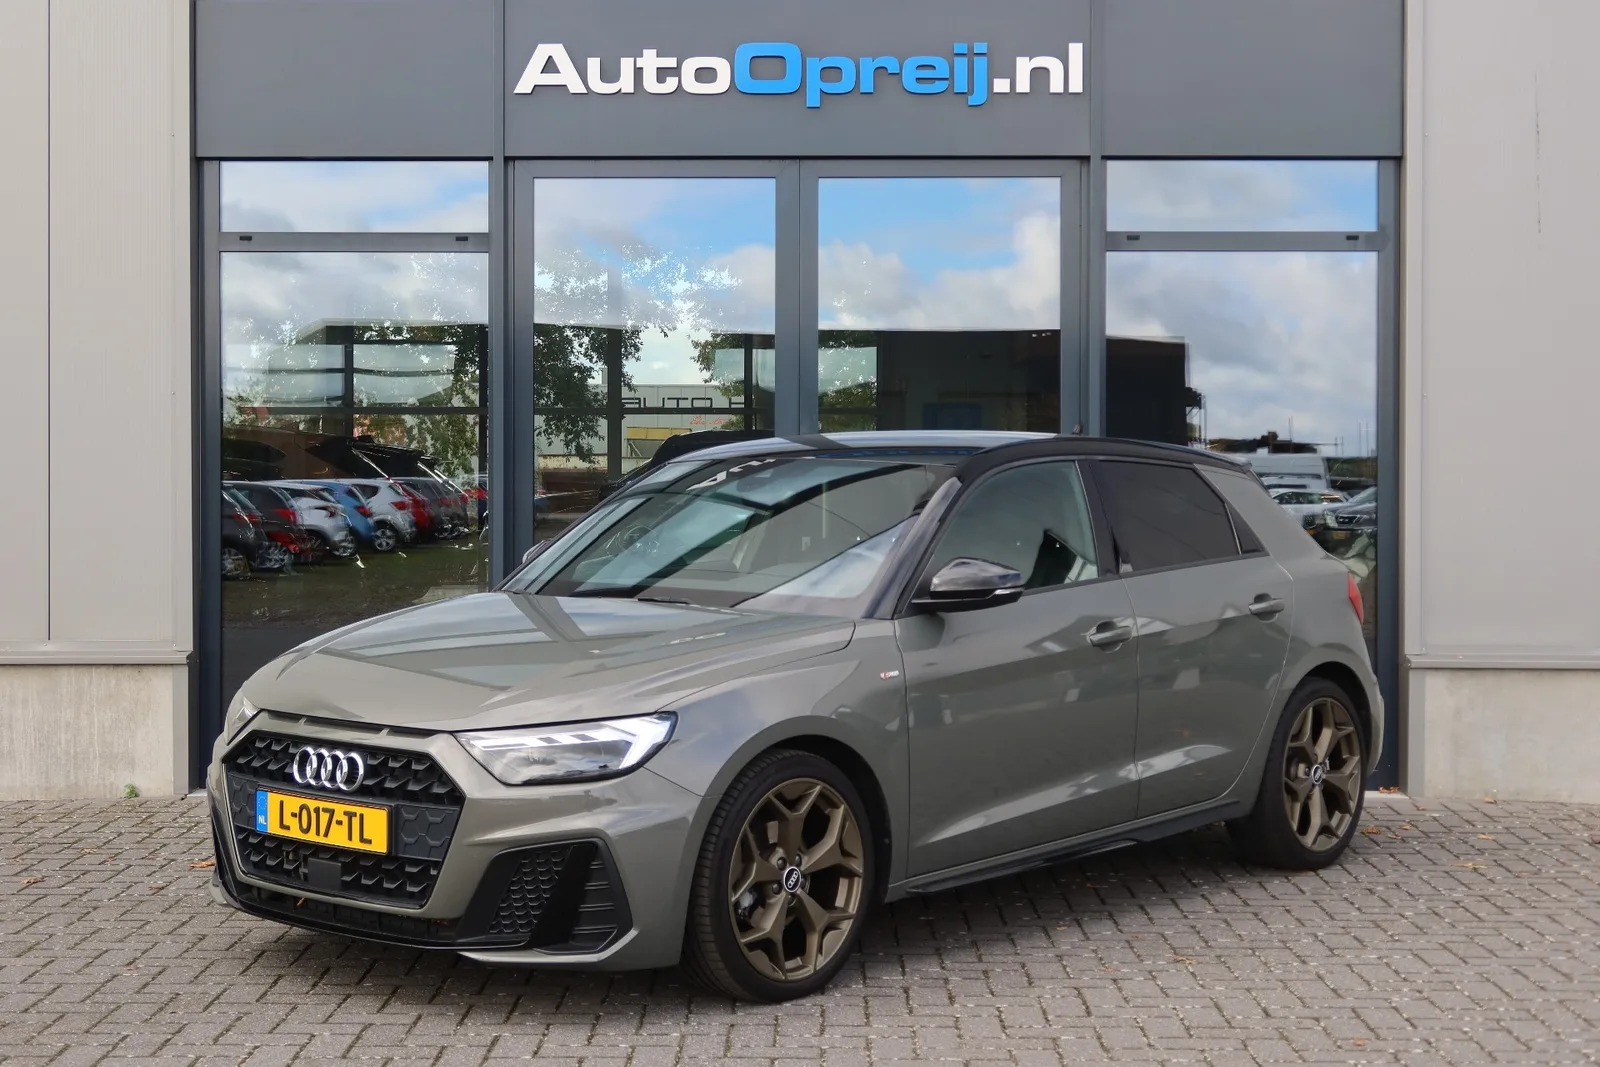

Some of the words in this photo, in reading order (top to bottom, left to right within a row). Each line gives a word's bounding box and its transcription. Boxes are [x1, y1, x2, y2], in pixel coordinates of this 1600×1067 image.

[513, 41, 1084, 108] AutoOpreij.nl
[258, 814, 267, 825] NL
[278, 799, 373, 846] L-017-TL
